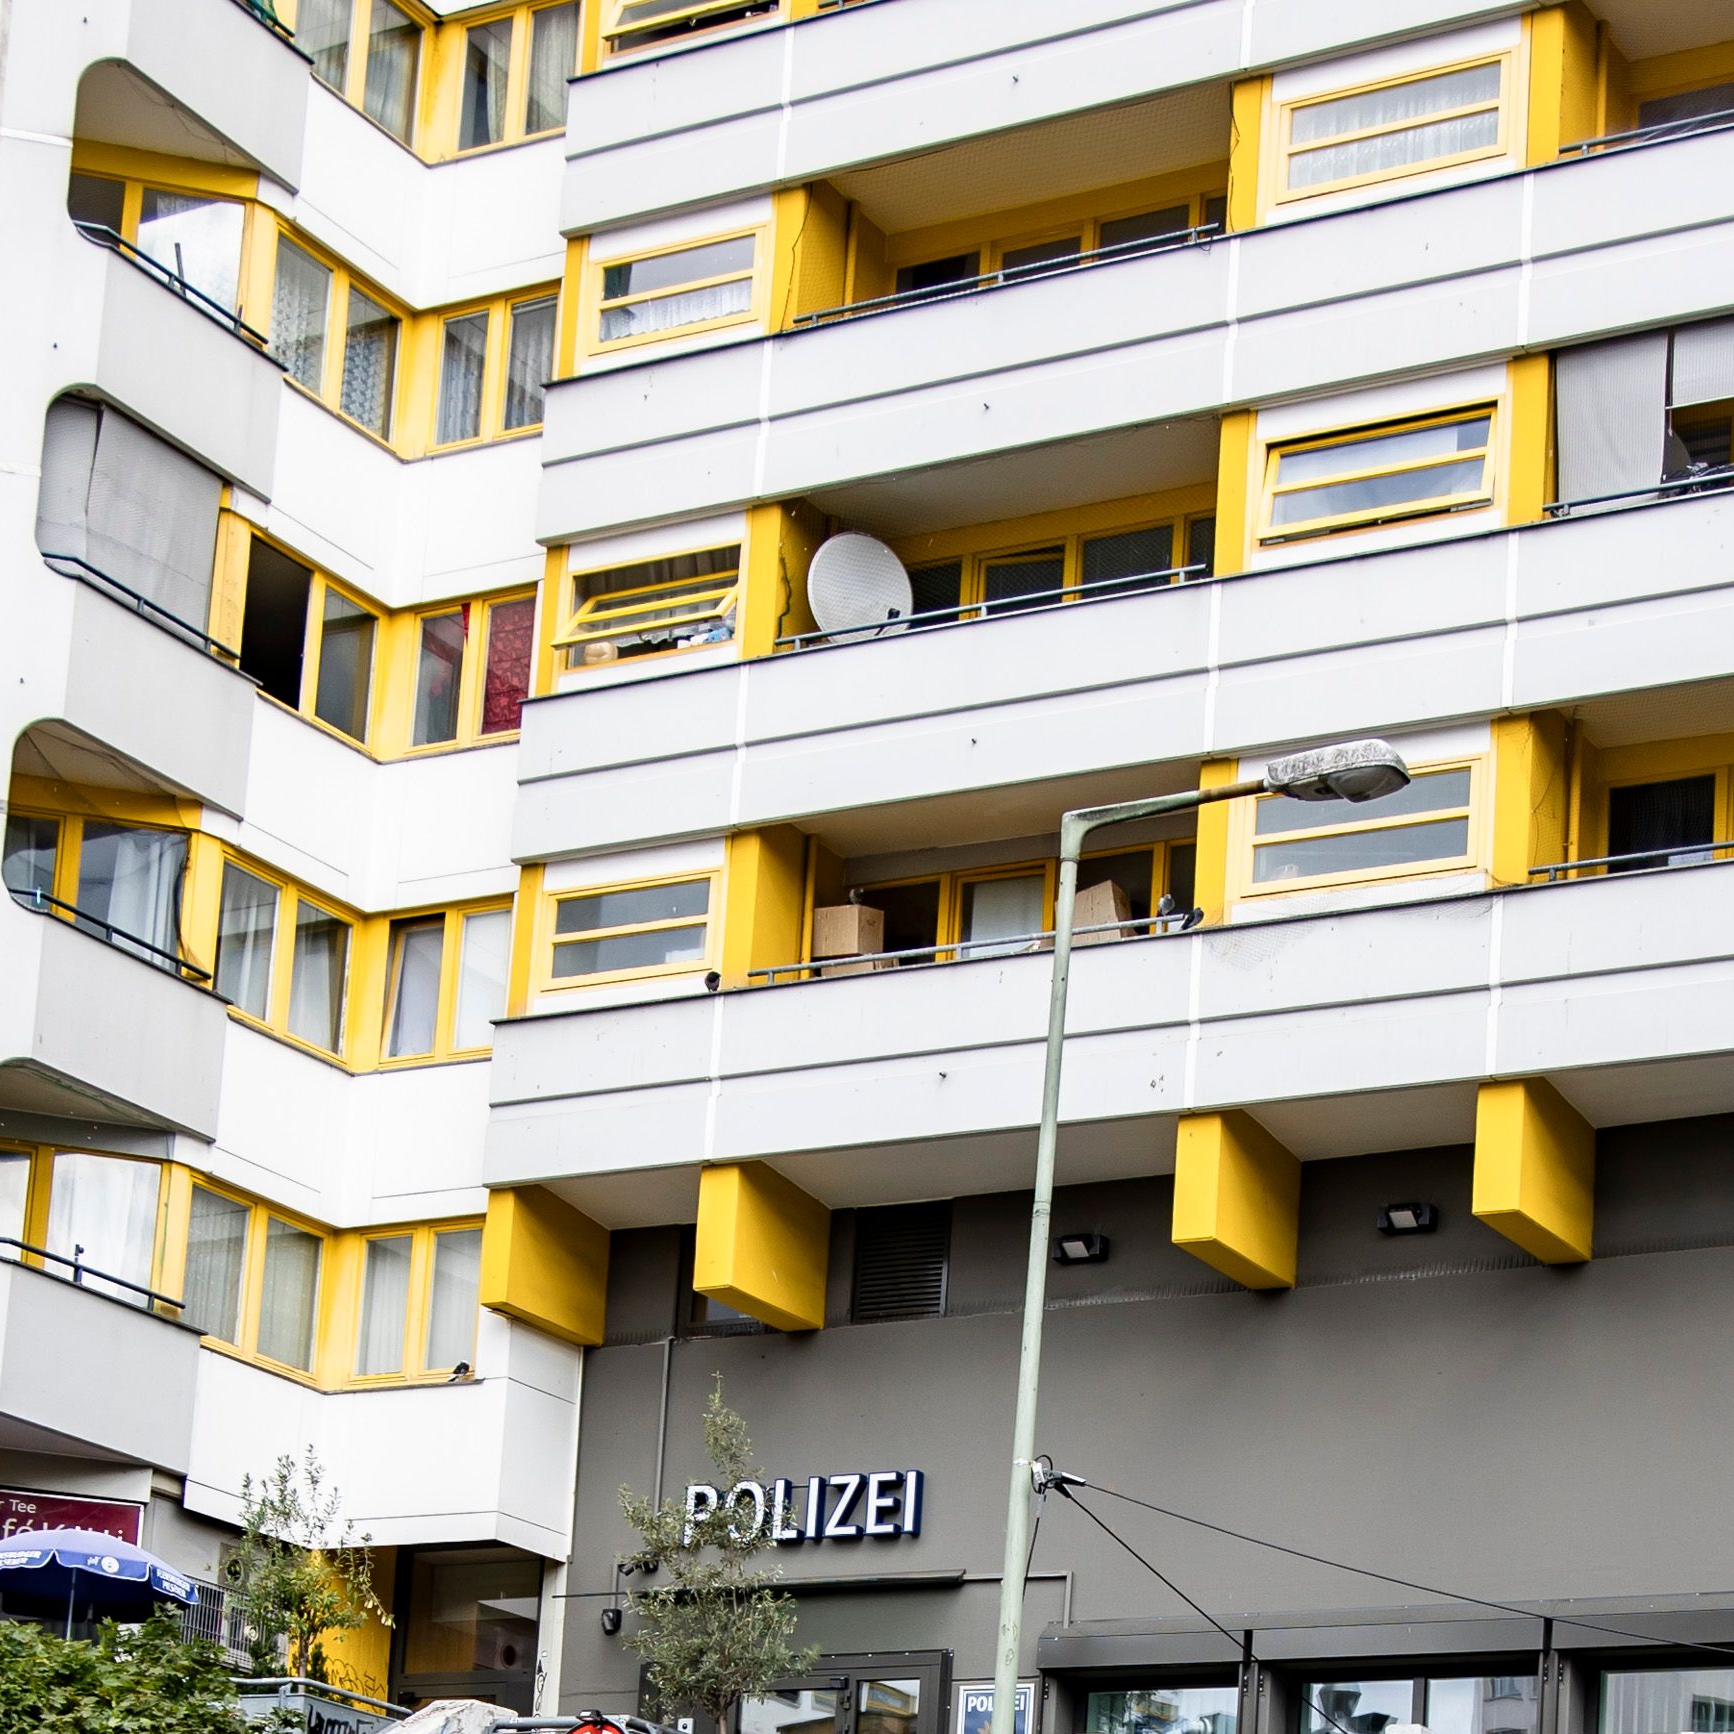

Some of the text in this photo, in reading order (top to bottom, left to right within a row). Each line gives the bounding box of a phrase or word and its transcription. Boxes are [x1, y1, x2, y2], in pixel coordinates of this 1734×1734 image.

[10, 1499, 36, 1514] Tee
[682, 1470, 923, 1547] POLIZEI
[967, 1695, 1026, 1712] POLEI
